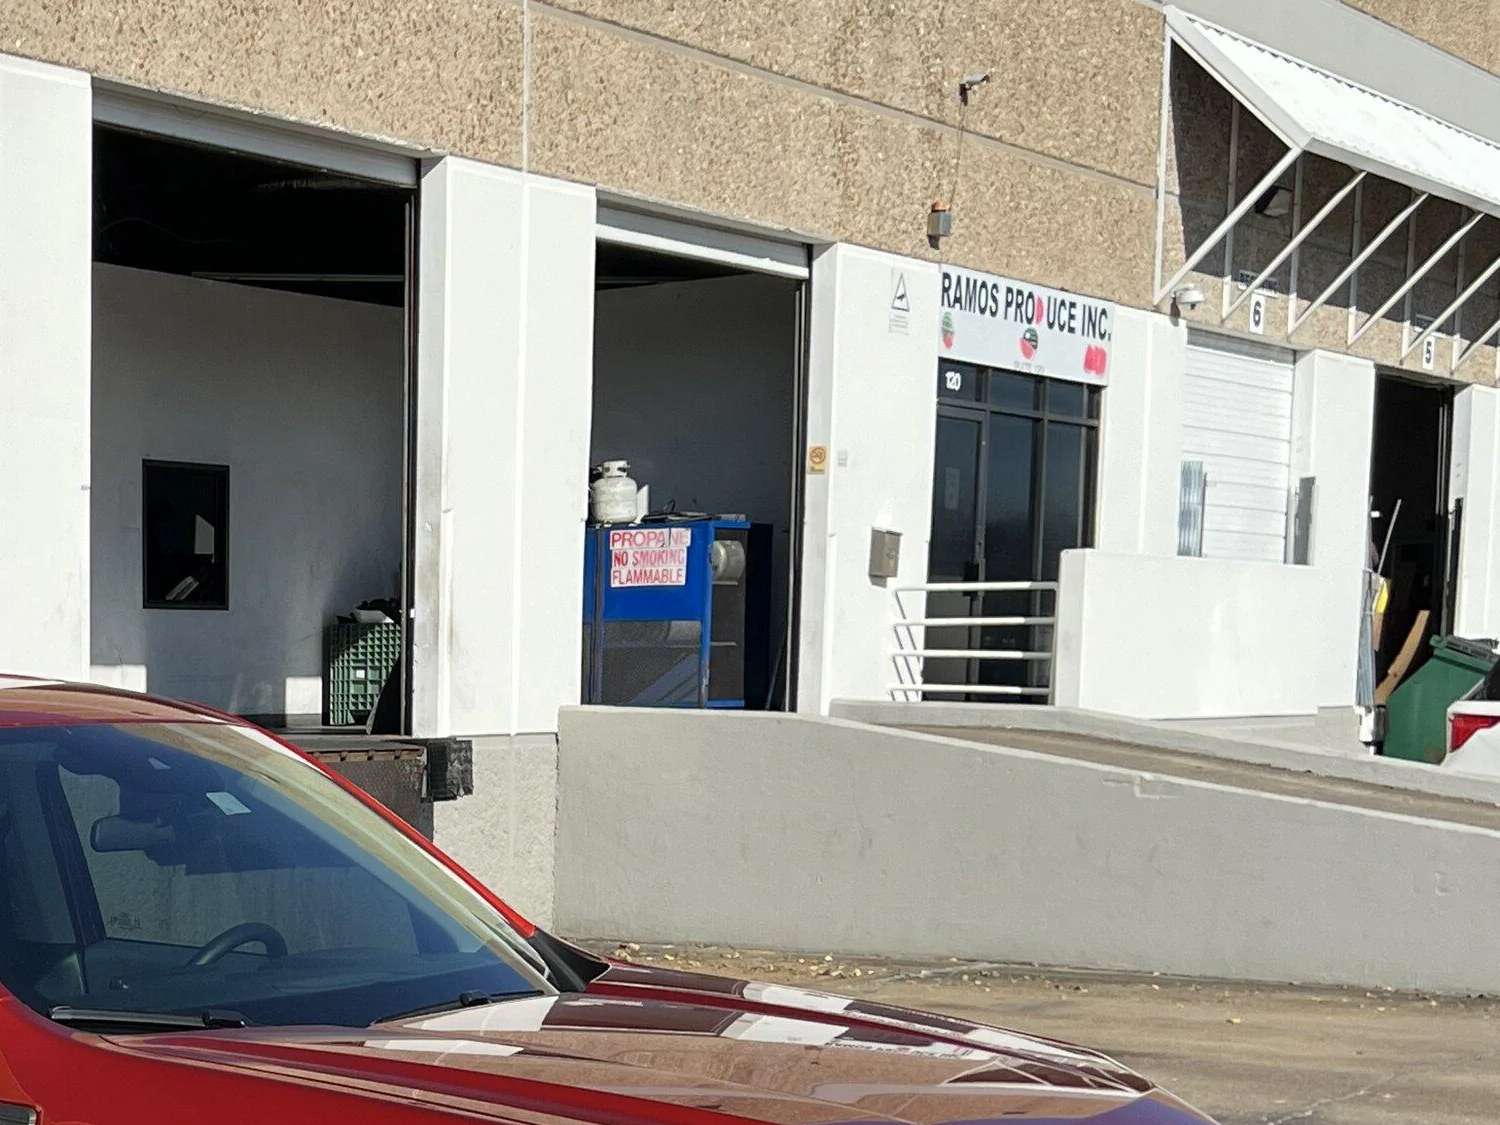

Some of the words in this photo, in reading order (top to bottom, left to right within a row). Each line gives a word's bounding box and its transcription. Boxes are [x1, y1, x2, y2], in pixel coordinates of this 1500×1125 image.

[941, 272, 999, 318] RAMOS
[1003, 286, 1077, 335] PRODUCE
[1081, 304, 1112, 342] INC.
[1252, 300, 1262, 328] 6
[1425, 341, 1432, 364] 5
[945, 371, 962, 391] 120
[613, 551, 629, 567] NO
[632, 549, 685, 567] SMOKING
[612, 568, 684, 585] FLAMMABLE
